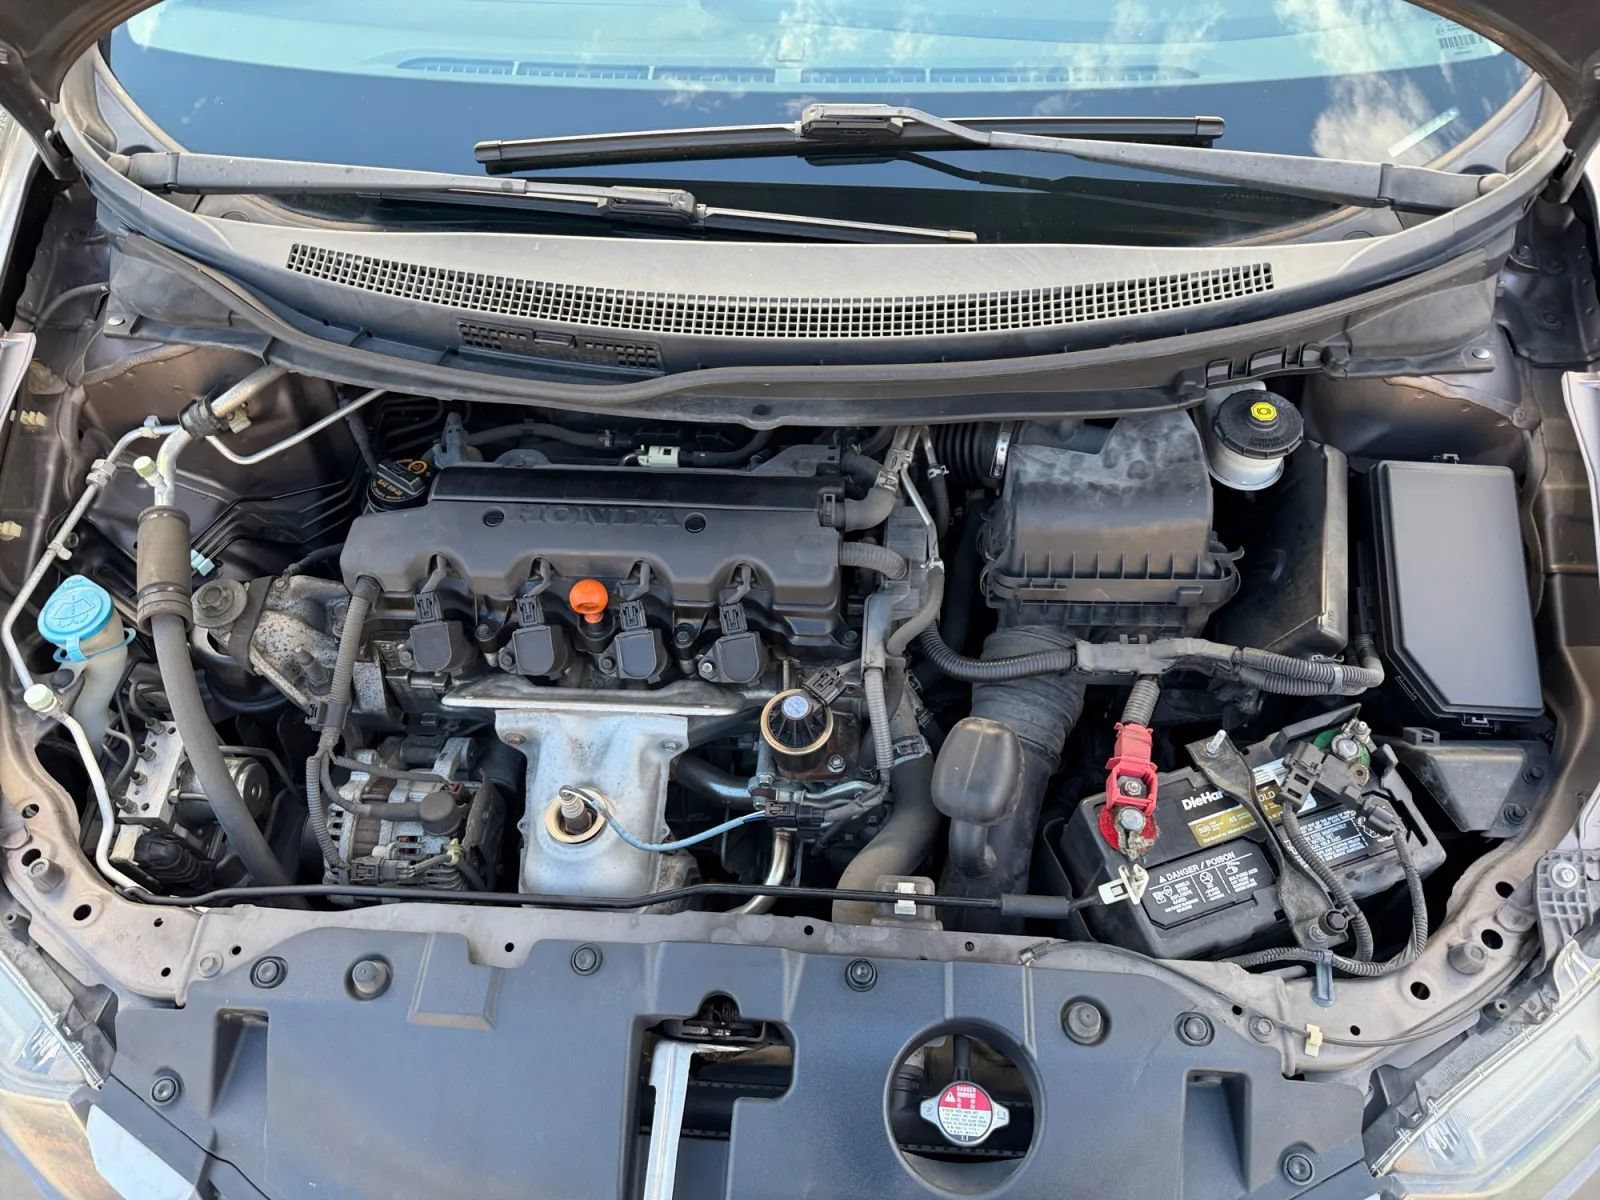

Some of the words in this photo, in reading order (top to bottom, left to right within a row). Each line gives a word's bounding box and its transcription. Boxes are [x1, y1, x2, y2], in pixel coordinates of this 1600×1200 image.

[520, 507, 681, 527] HONDA
[1182, 790, 1224, 810] DieHar
[1257, 790, 1275, 802] OLD
[1166, 864, 1199, 880] DANGER
[1206, 851, 1235, 866] POISON
